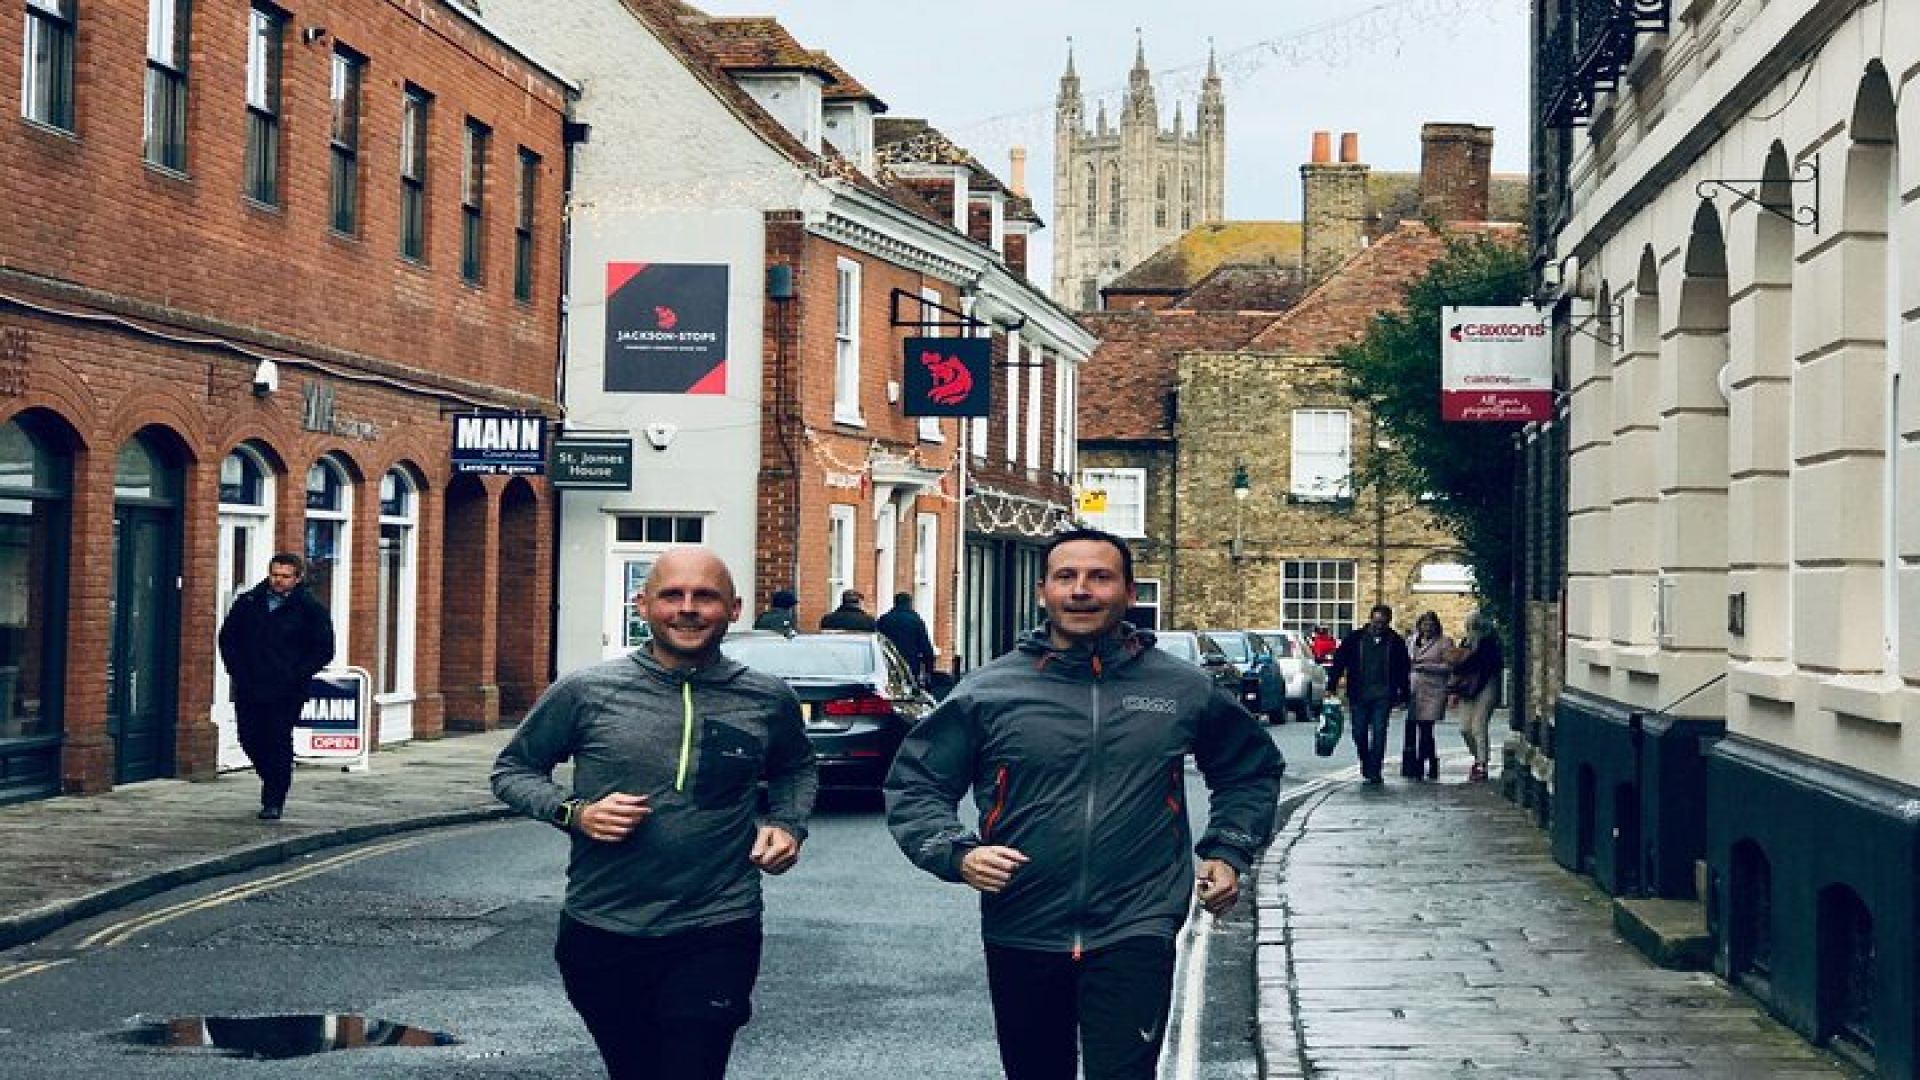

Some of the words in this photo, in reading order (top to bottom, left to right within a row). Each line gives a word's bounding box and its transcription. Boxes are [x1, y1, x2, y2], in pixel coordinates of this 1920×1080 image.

[1463, 324, 1545, 336] caxtons
[458, 418, 540, 450] MANN
[580, 452, 624, 465] James
[569, 464, 613, 477] House
[315, 737, 356, 748] OPEN
